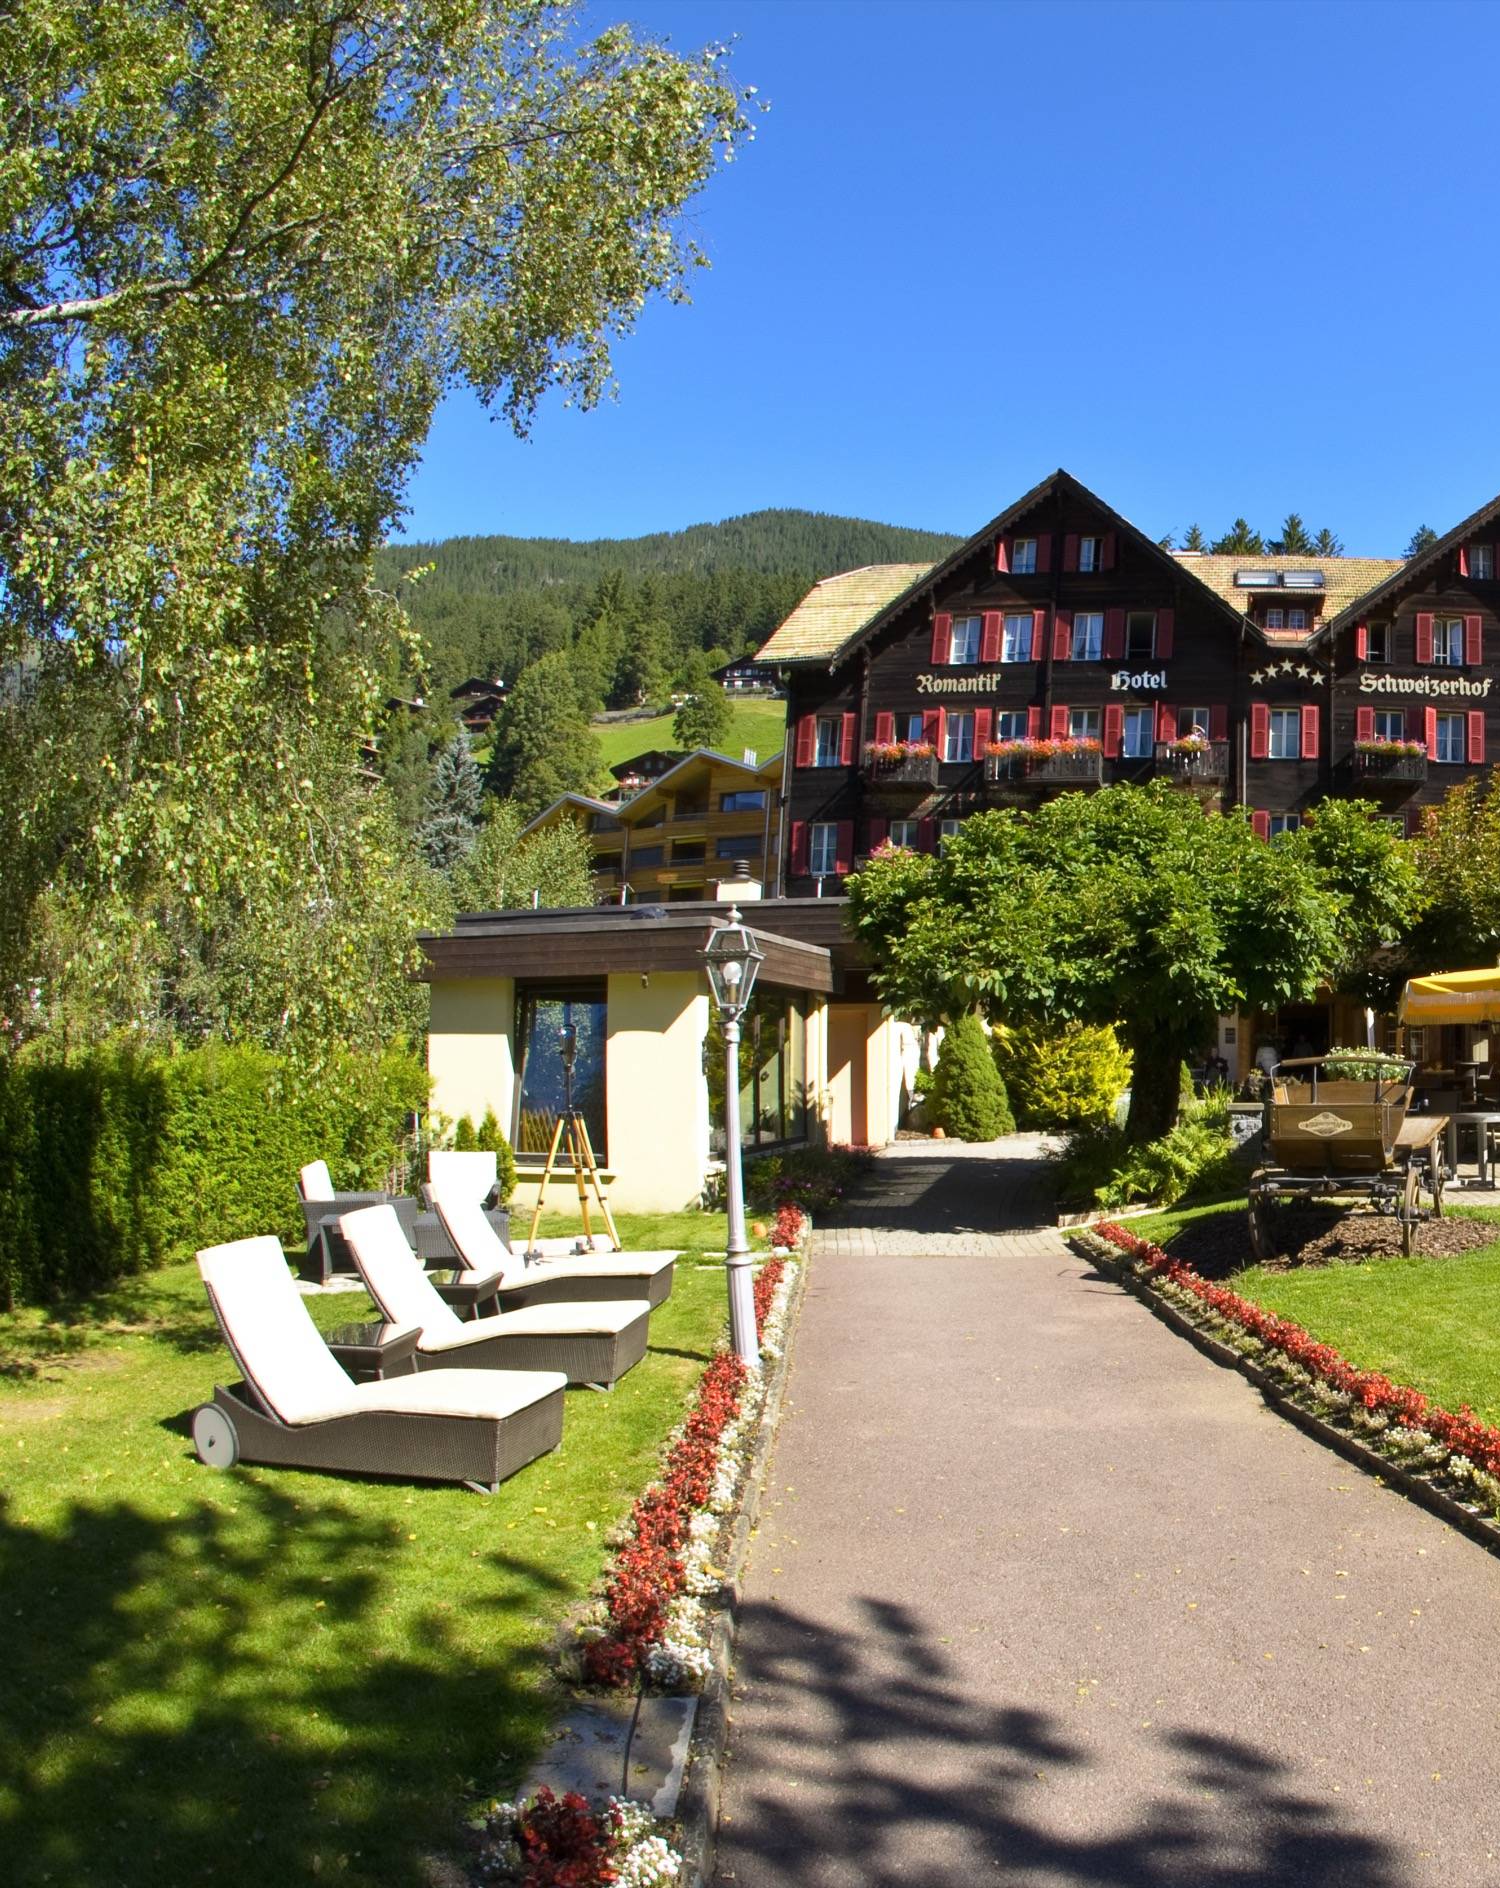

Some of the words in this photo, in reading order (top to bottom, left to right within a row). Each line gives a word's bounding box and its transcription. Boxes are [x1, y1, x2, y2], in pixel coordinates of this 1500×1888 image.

[916, 672, 1001, 694] Romantik
[1110, 670, 1168, 691] Hotel
[1359, 672, 1492, 698] Schweizerhof
